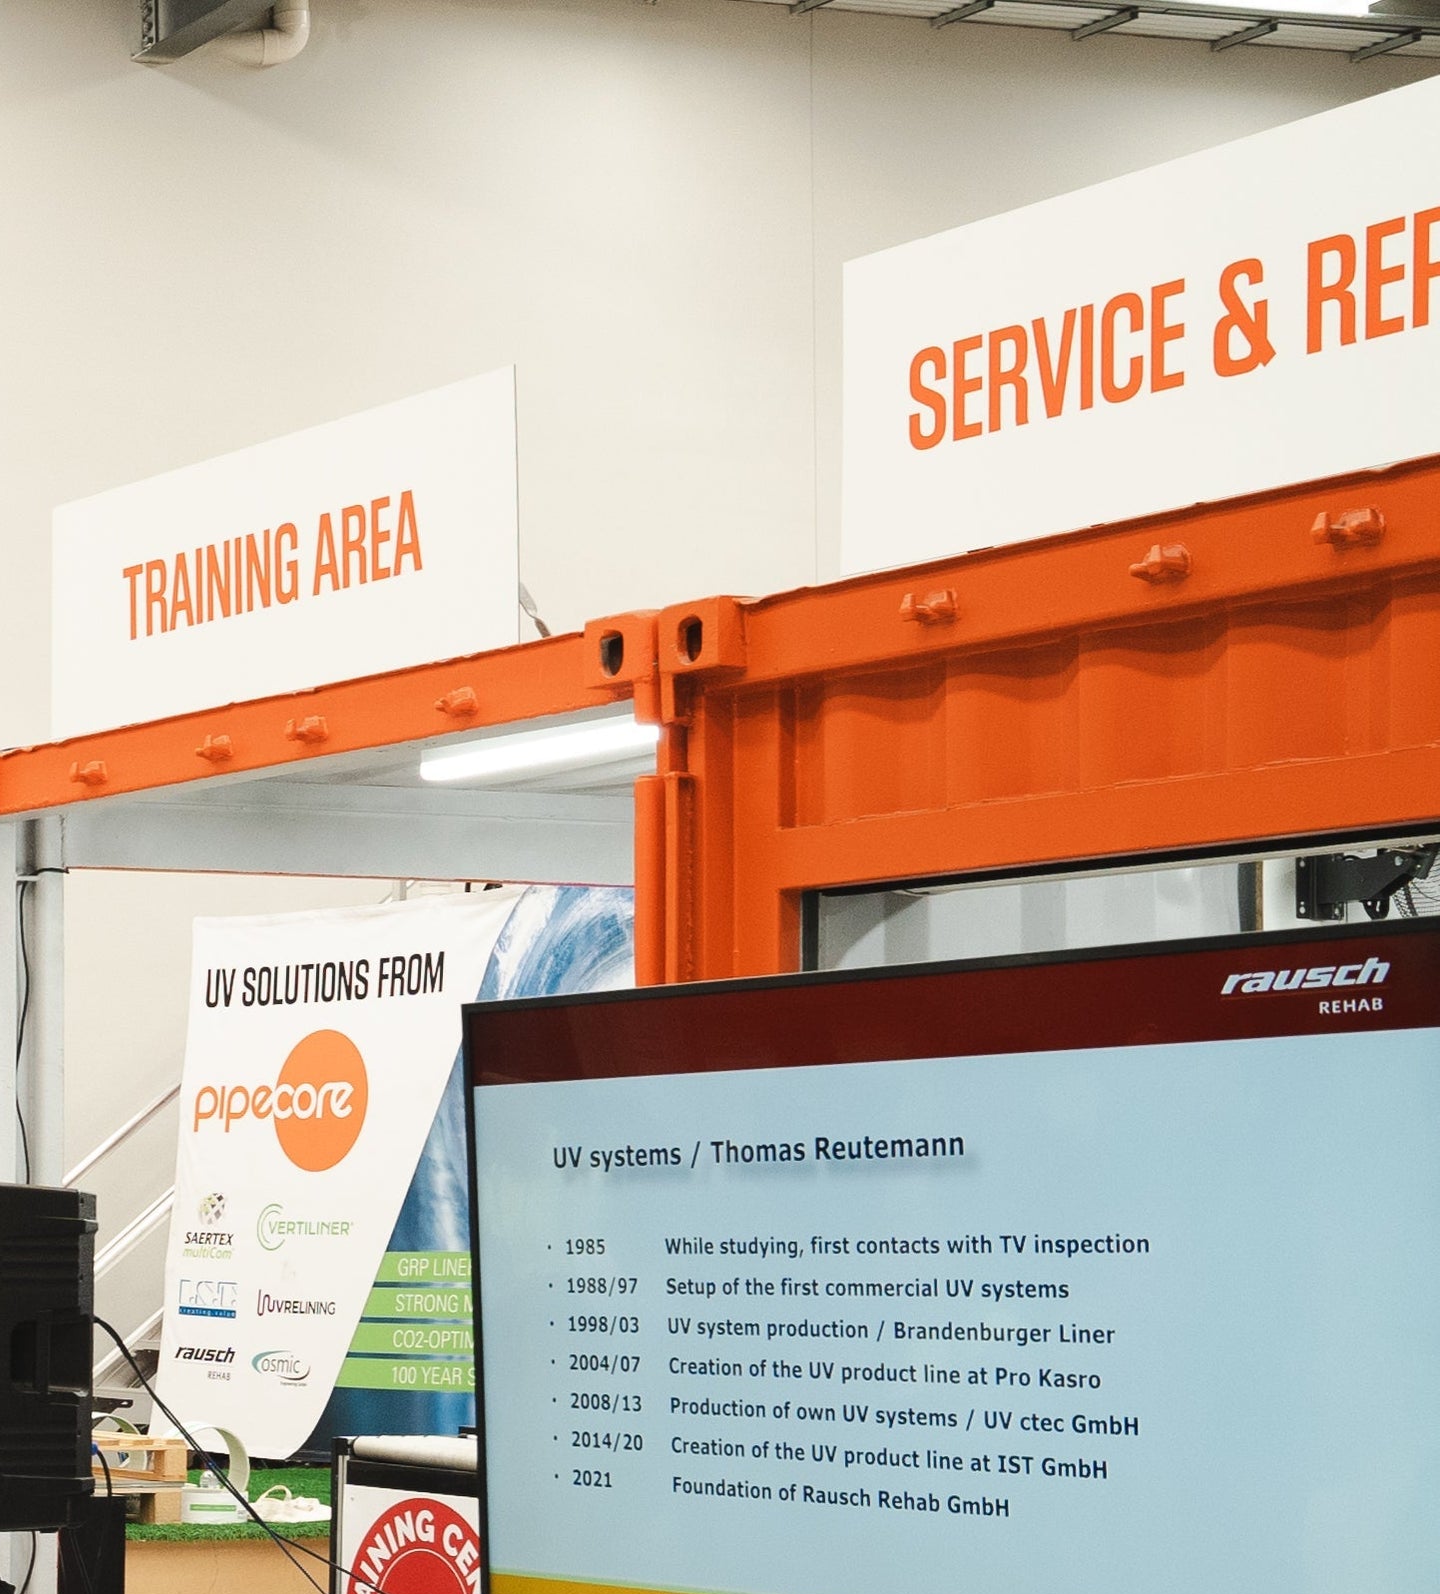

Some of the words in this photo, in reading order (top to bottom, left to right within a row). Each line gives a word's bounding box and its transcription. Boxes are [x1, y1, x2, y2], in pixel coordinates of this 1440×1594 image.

[907, 278, 1187, 453] SERVICE
[1212, 256, 1277, 380] &
[121, 520, 300, 643] TRAINING
[312, 489, 423, 599] AREA
[205, 967, 236, 1009] UV
[242, 957, 370, 1008] SOLUTIONS
[377, 950, 445, 999] FROM
[1220, 957, 1391, 995] rausch
[1319, 998, 1383, 1014] REHAB
[193, 1081, 354, 1133] pipecore
[553, 1146, 582, 1168] UV
[590, 1144, 682, 1172] systems
[690, 1141, 701, 1168] /
[711, 1139, 806, 1163] Thomas
[815, 1136, 965, 1161] Reutemann
[184, 1232, 234, 1246] SAERTEX
[268, 1221, 350, 1236] VERTILINER
[565, 1239, 606, 1255] 1985
[665, 1237, 714, 1255] While
[720, 1236, 804, 1259] studying,
[811, 1236, 850, 1254] first
[856, 1236, 940, 1254] contacts
[947, 1235, 992, 1254] with
[999, 1235, 1027, 1254] TV
[1034, 1234, 1150, 1258] inspection
[397, 1258, 429, 1276] GRP
[395, 1293, 459, 1313] STRONG
[566, 1277, 638, 1297] 1988/97
[666, 1277, 717, 1299] Setup
[722, 1277, 740, 1296] of
[745, 1278, 775, 1296] the
[781, 1277, 819, 1296] first
[825, 1278, 938, 1298] commercial
[946, 1279, 974, 1298] UV
[981, 1280, 1069, 1302] systems
[568, 1315, 640, 1335] 1998/03
[668, 1317, 691, 1335] UV
[697, 1318, 760, 1339] system
[767, 1318, 868, 1341] production
[876, 1320, 885, 1342] /
[894, 1321, 1051, 1346] Brandenburger
[1059, 1323, 1116, 1344] Liner
[175, 1346, 236, 1364] rausch
[207, 1371, 231, 1381] REHAB
[391, 1366, 417, 1384] 100
[421, 1366, 463, 1385] YEAR
[569, 1354, 641, 1375] 2004/07
[669, 1357, 742, 1377] Creation
[749, 1359, 767, 1377] of
[772, 1360, 802, 1379] the
[809, 1361, 834, 1379] UV
[841, 1362, 917, 1385] product
[924, 1364, 961, 1385] line
[967, 1368, 988, 1385] at
[995, 1367, 1031, 1387] Pro
[1039, 1368, 1101, 1389] Kasro
[570, 1392, 642, 1413] 2008/13
[670, 1397, 766, 1418] Production
[772, 1401, 790, 1418] of
[796, 1406, 836, 1422] own
[842, 1404, 869, 1423] UV
[875, 1407, 958, 1429] systems
[965, 1409, 975, 1432] /
[984, 1411, 1012, 1430] UV
[1020, 1414, 1064, 1433] ctec
[1072, 1414, 1139, 1436] GmbH
[571, 1431, 643, 1452] 2014/20
[671, 1436, 745, 1458] Creation
[751, 1441, 770, 1459] of
[775, 1442, 805, 1461] the
[811, 1444, 837, 1463] UV
[844, 1447, 920, 1469] product
[927, 1450, 963, 1470] line
[970, 1454, 991, 1473] at
[998, 1454, 1033, 1475] IST
[1041, 1457, 1108, 1480] GmbH
[572, 1469, 613, 1488] 2021
[672, 1476, 772, 1500] Foundation
[779, 1483, 797, 1502] of
[803, 1485, 871, 1507] Rausch
[878, 1490, 940, 1513] Rehab
[947, 1494, 1010, 1517] GmbH
